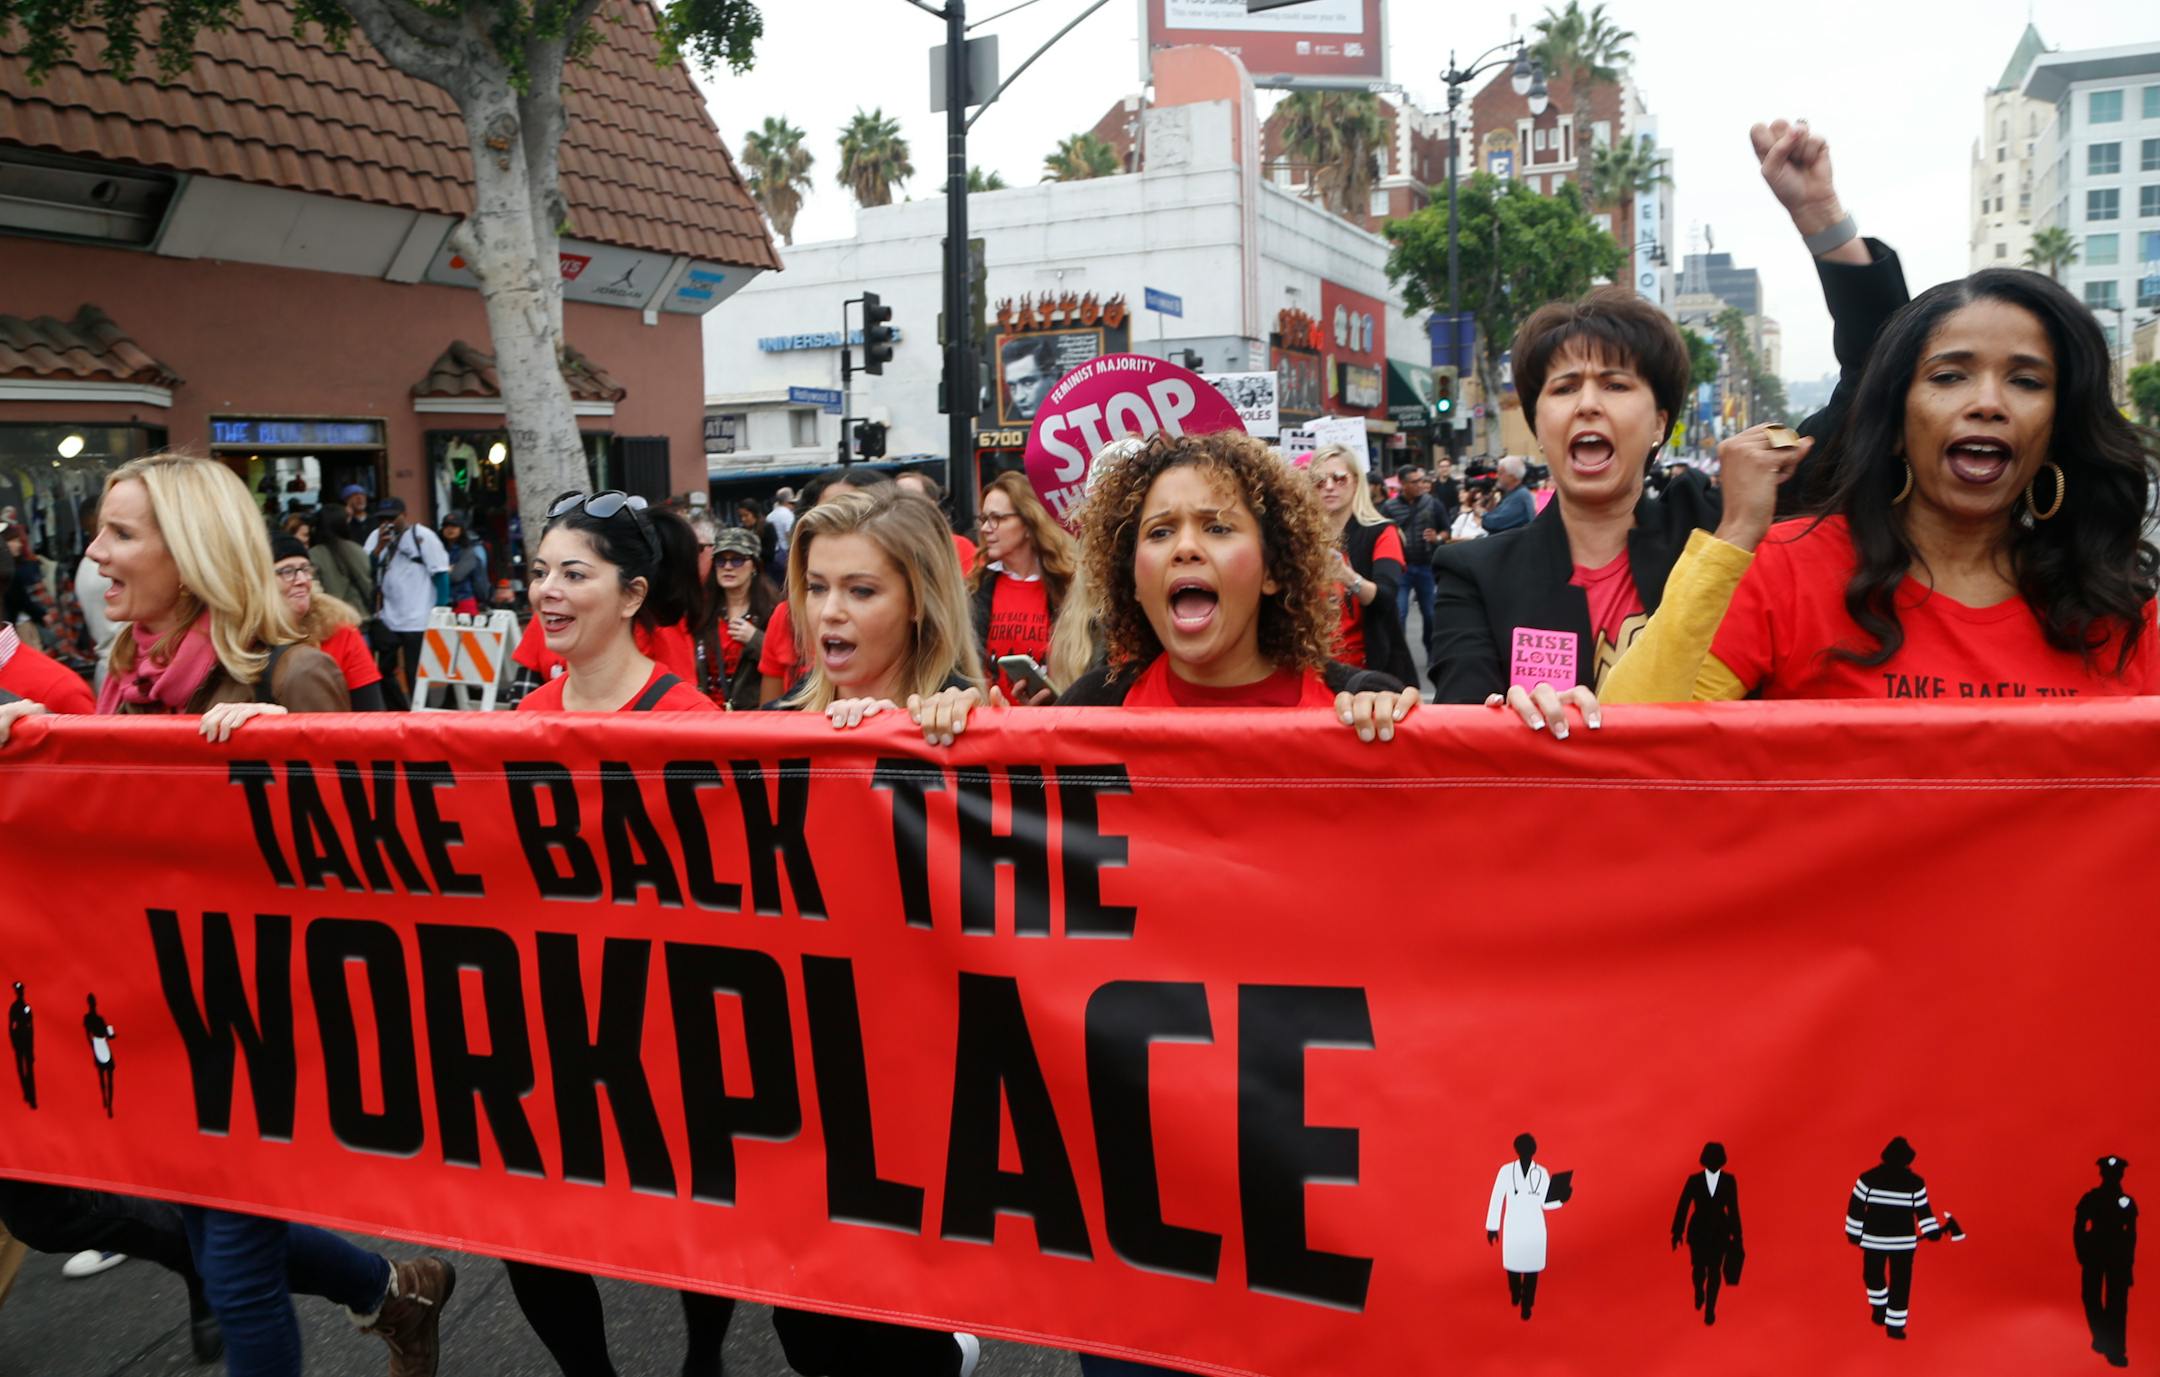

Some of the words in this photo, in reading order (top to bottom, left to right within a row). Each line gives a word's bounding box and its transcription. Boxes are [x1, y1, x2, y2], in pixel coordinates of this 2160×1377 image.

[592, 286, 643, 298] JORDAN
[995, 290, 1127, 336] TATTOO
[757, 331, 842, 353] UNIVERSAL
[1051, 365, 1094, 405] FEMINIST
[1096, 357, 1157, 375] MAJORITY
[213, 422, 250, 443] THE
[979, 431, 1023, 447] 6700
[1039, 378, 1196, 483] STOP
[1517, 633, 1573, 651] RISE
[1516, 650, 1573, 667] LOVE
[1515, 665, 1573, 680] RESIST
[1883, 673, 1945, 699] TAKE
[228, 760, 485, 897] TAKE
[502, 758, 829, 920] BACK
[873, 757, 1138, 940] THE
[145, 908, 1376, 1313] WORKPLACE
